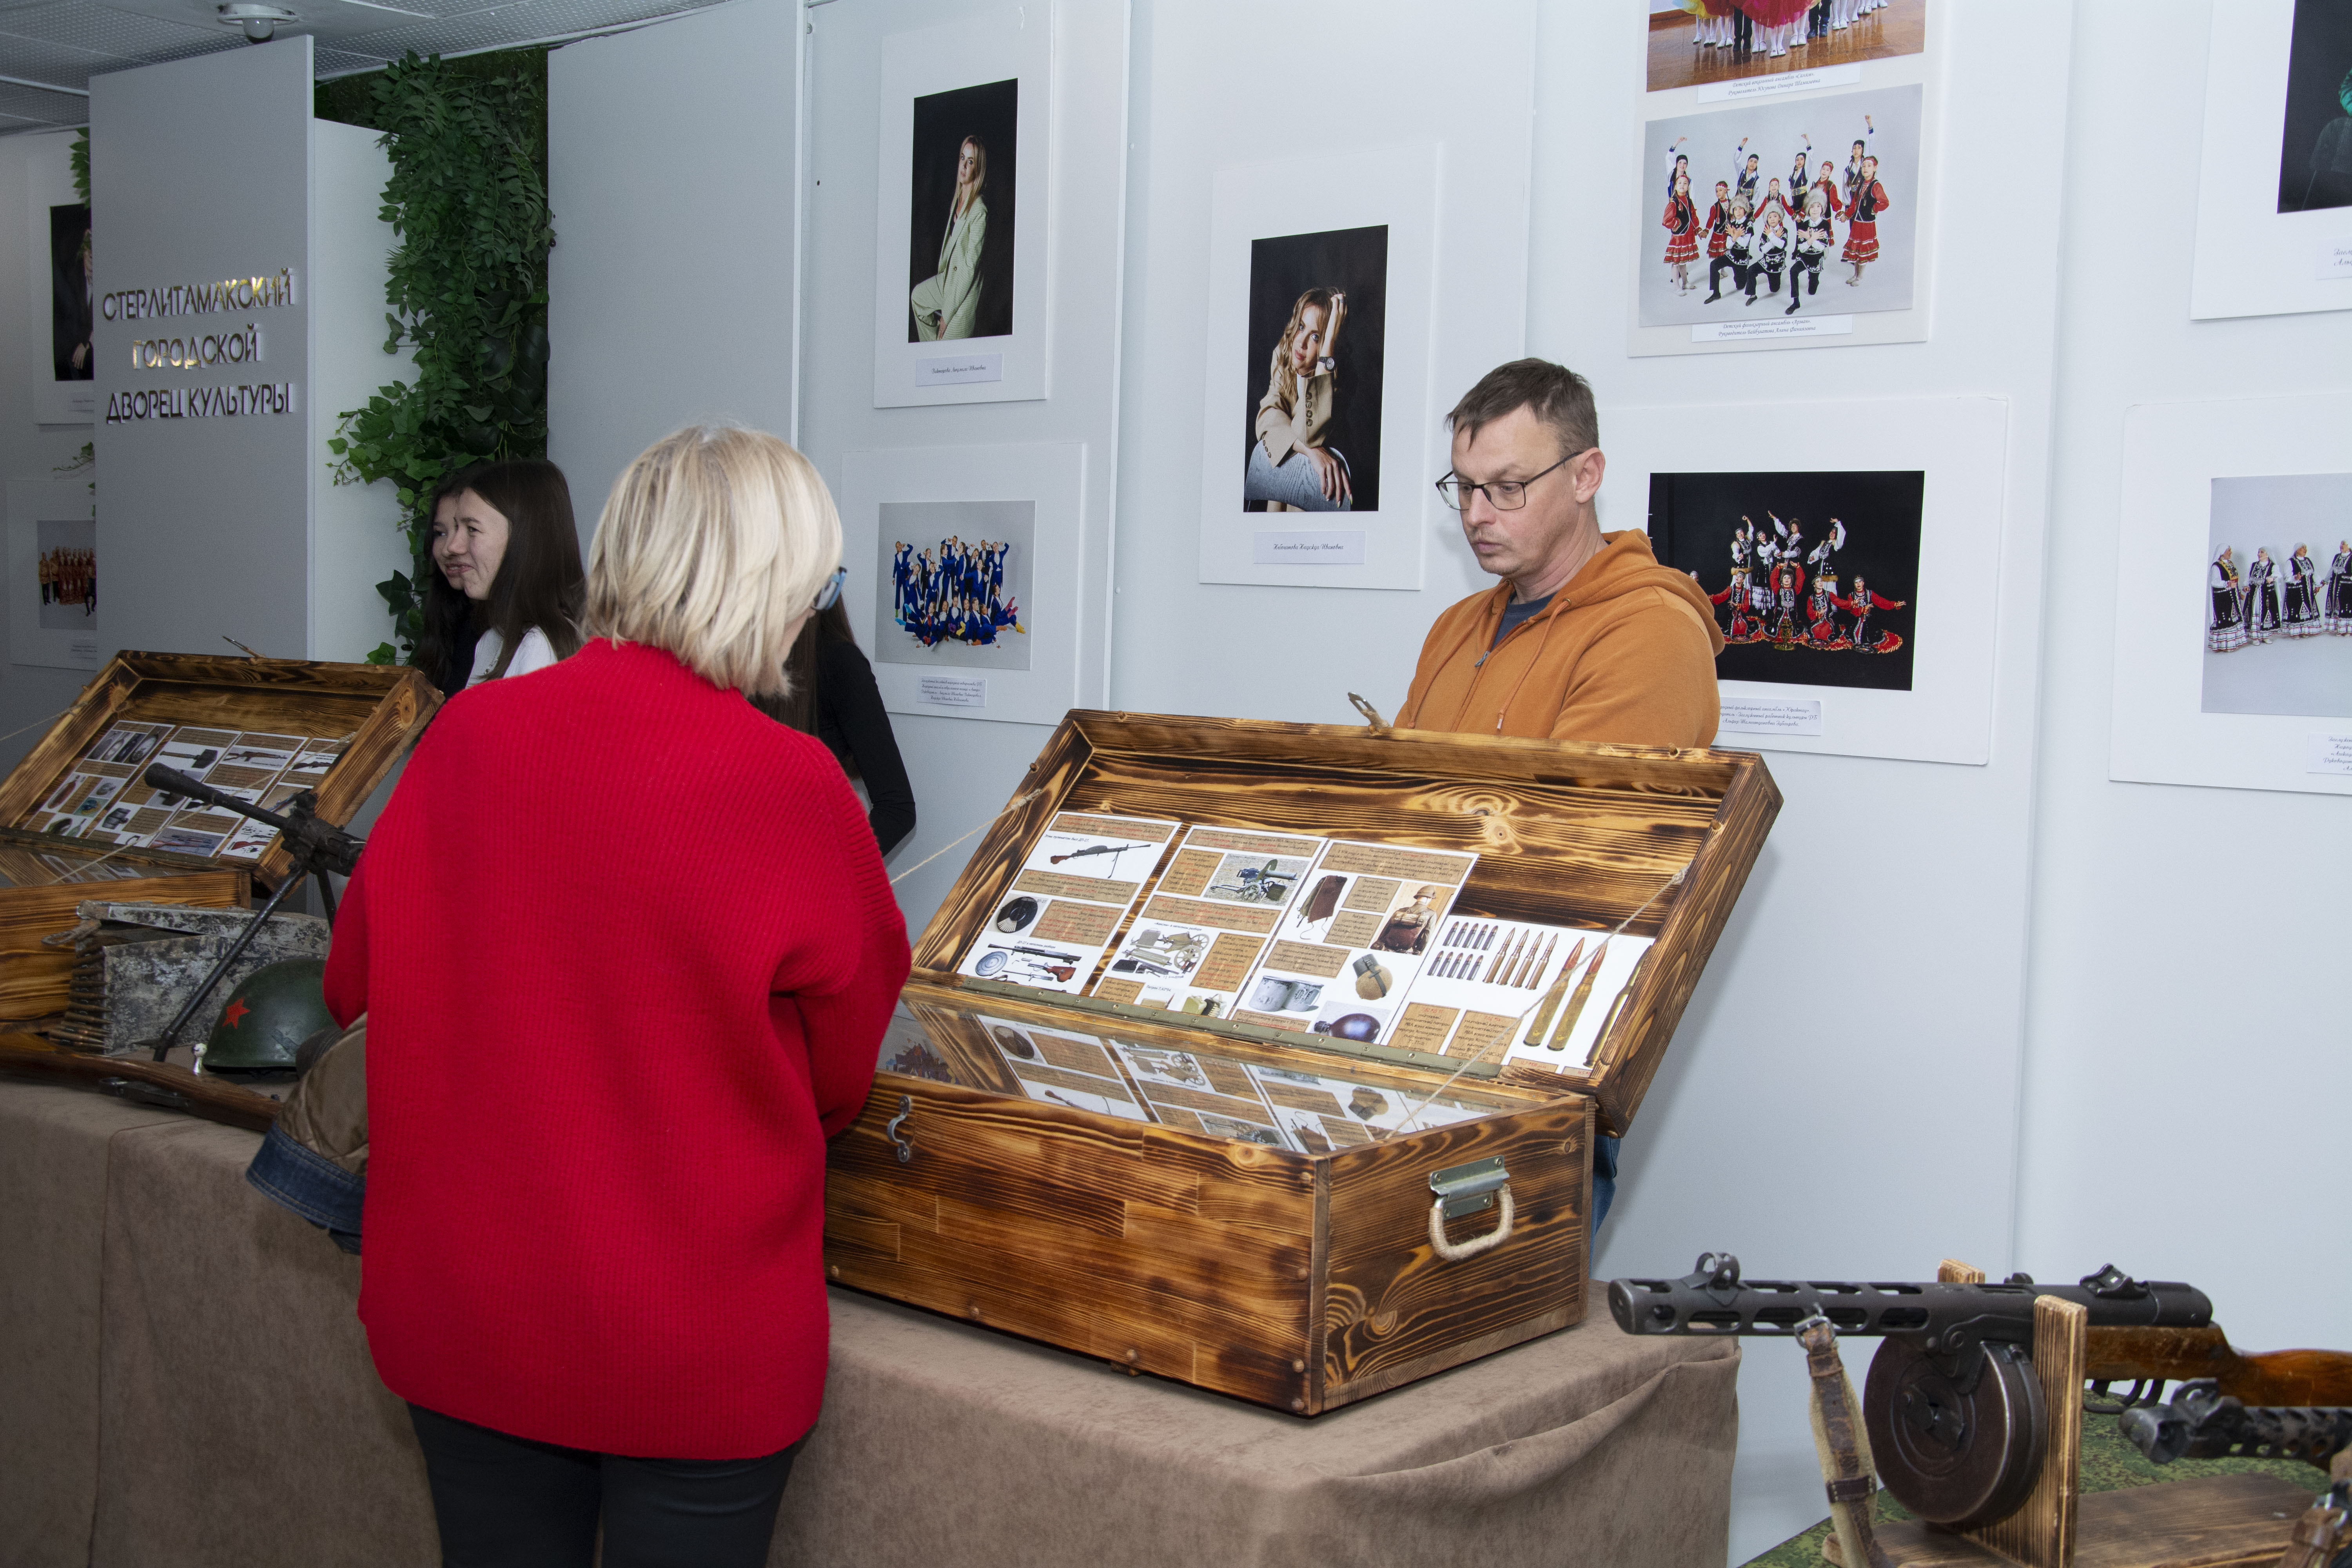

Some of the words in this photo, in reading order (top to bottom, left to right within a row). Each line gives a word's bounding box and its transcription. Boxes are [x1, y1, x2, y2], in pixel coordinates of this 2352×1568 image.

[103, 268, 295, 321] СТЕРЛИТАМАКСКИЙ
[132, 323, 261, 369] ГОРОДСКОЙ
[106, 388, 187, 424] ДВОРЕЦ
[189, 383, 293, 417] КУЛЬТУРЫ
